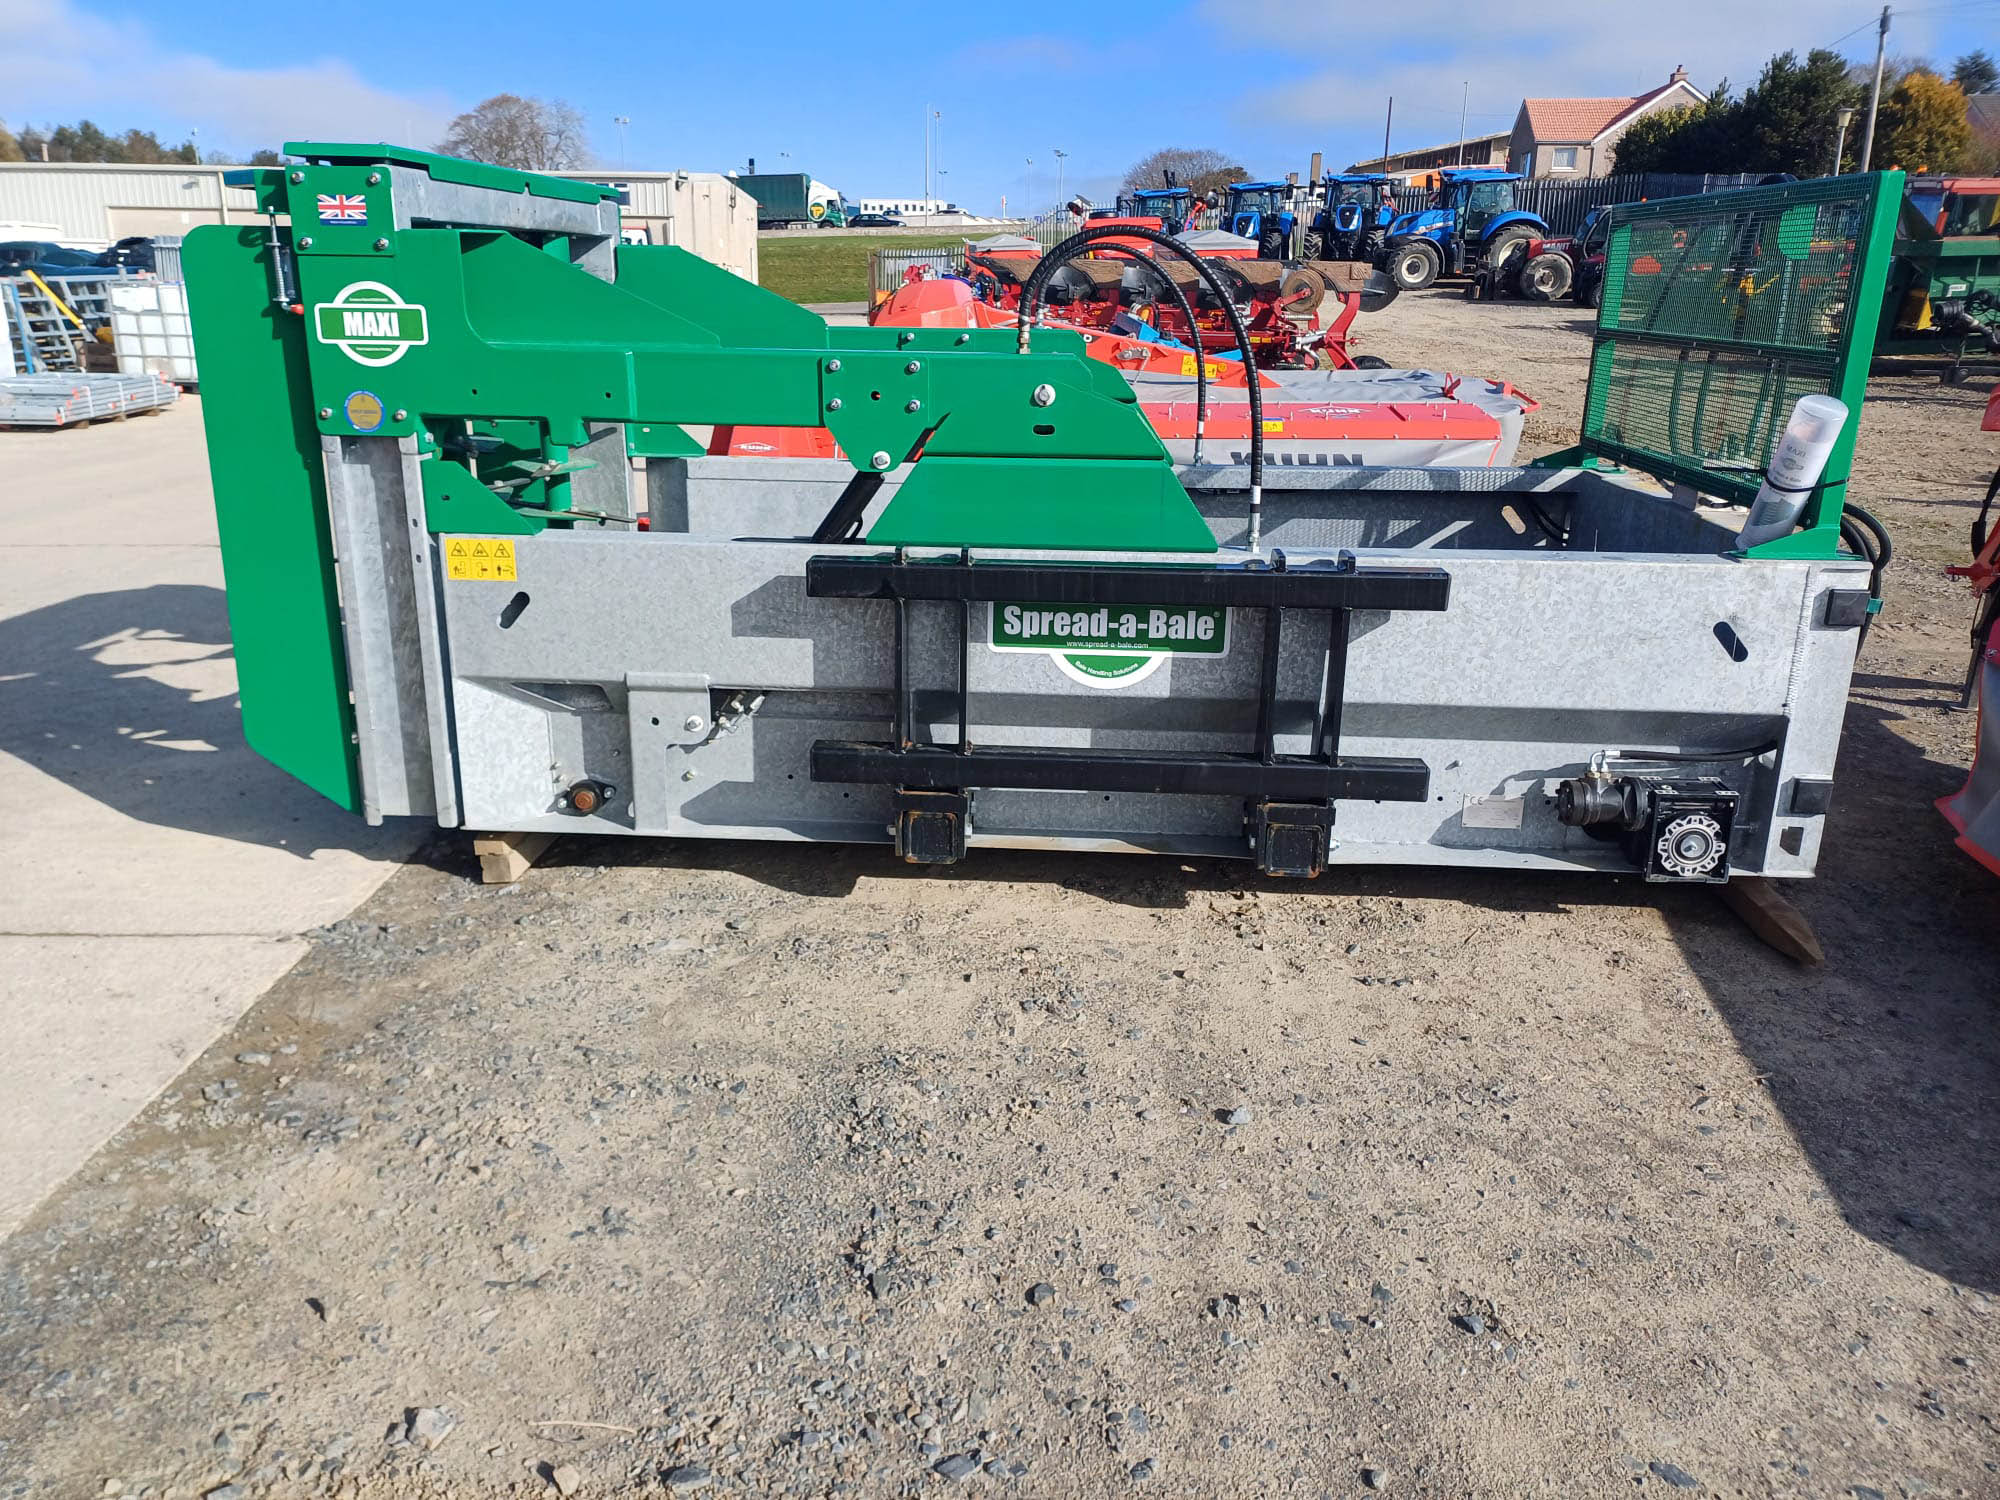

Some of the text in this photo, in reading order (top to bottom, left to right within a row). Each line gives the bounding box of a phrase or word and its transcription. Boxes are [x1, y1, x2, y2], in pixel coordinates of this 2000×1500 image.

[342, 311, 400, 337] MAXI
[1066, 641, 1149, 649] www.spread-a-bale.com
[1074, 660, 1139, 677] Bale Handling Solutions
